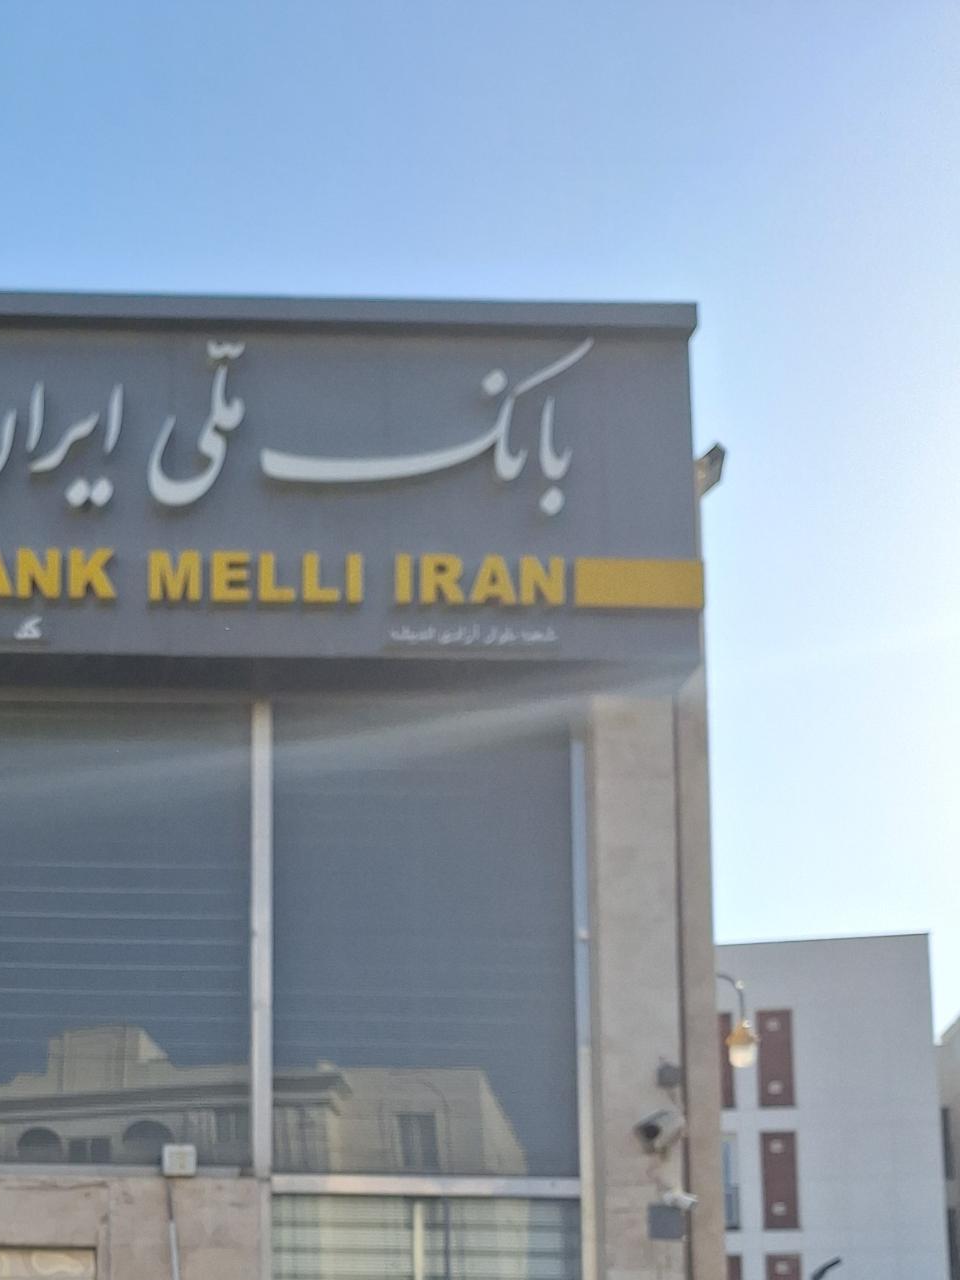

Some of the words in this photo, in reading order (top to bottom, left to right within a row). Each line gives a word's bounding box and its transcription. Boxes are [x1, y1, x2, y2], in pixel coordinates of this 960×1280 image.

[261, 338, 594, 516] بانک
[149, 551, 363, 605] MELLI
[395, 554, 566, 606] IRAN
